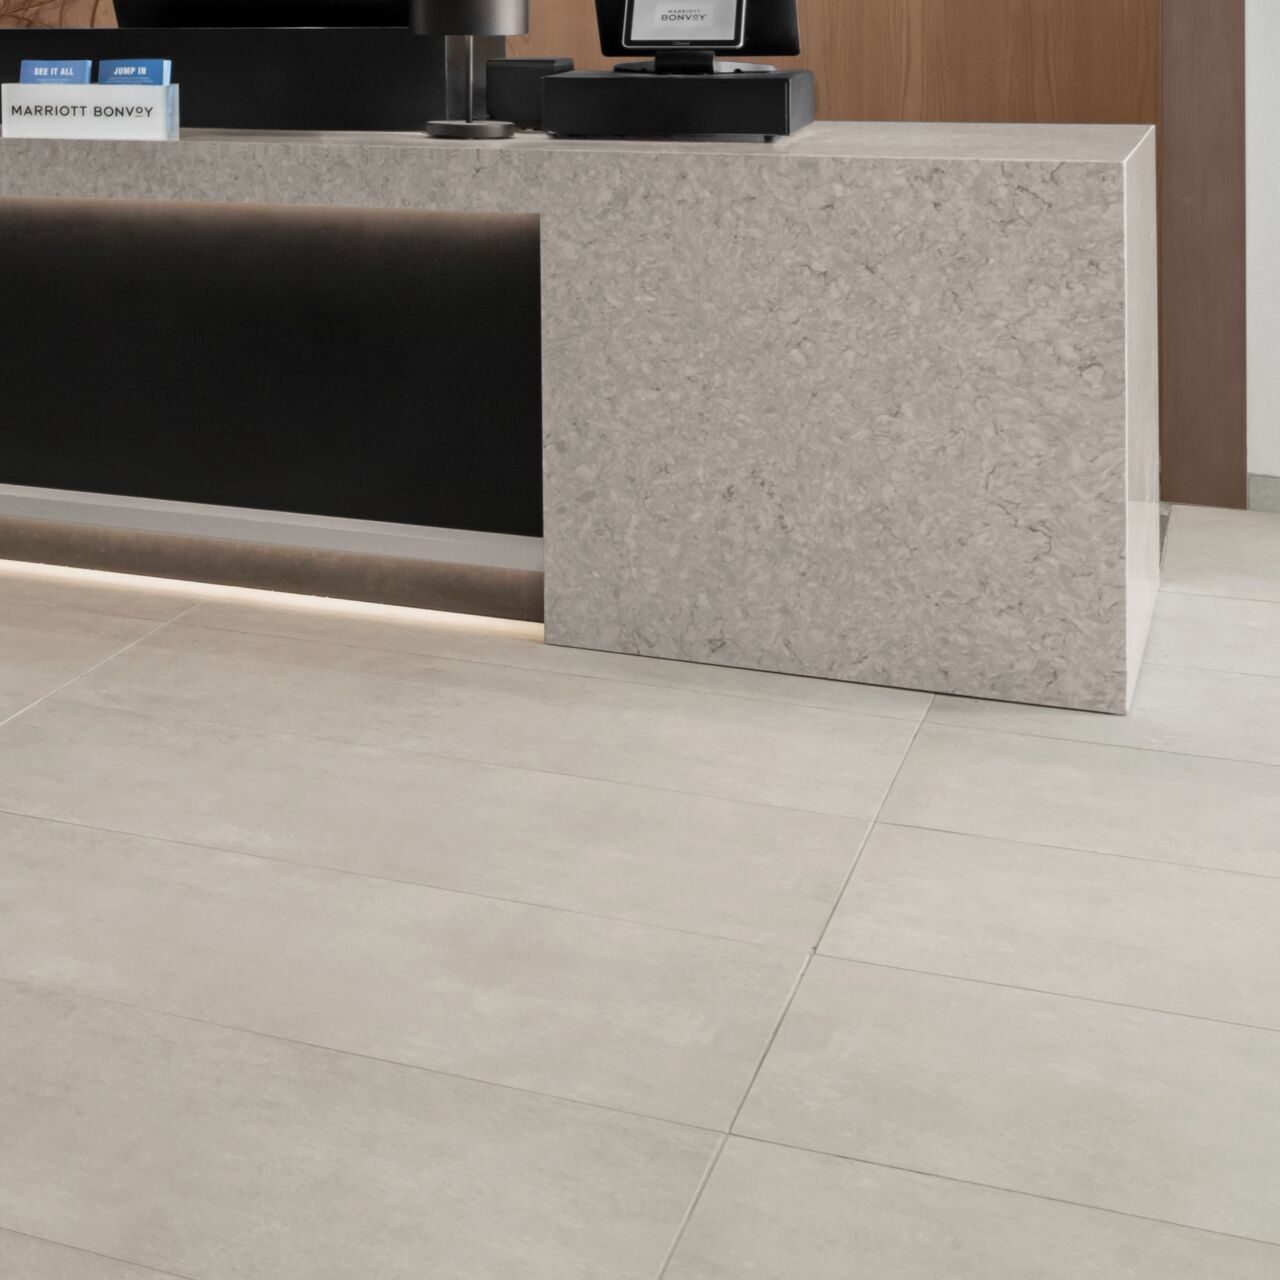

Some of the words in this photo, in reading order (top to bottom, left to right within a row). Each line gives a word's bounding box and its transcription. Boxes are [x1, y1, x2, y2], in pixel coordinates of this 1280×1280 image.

[34, 67, 48, 76] SEE
[50, 67, 58, 76] IT
[60, 67, 74, 76] ALL
[114, 66, 135, 76] JUMP
[137, 66, 147, 75] IN
[11, 105, 87, 117] MARRIOTT
